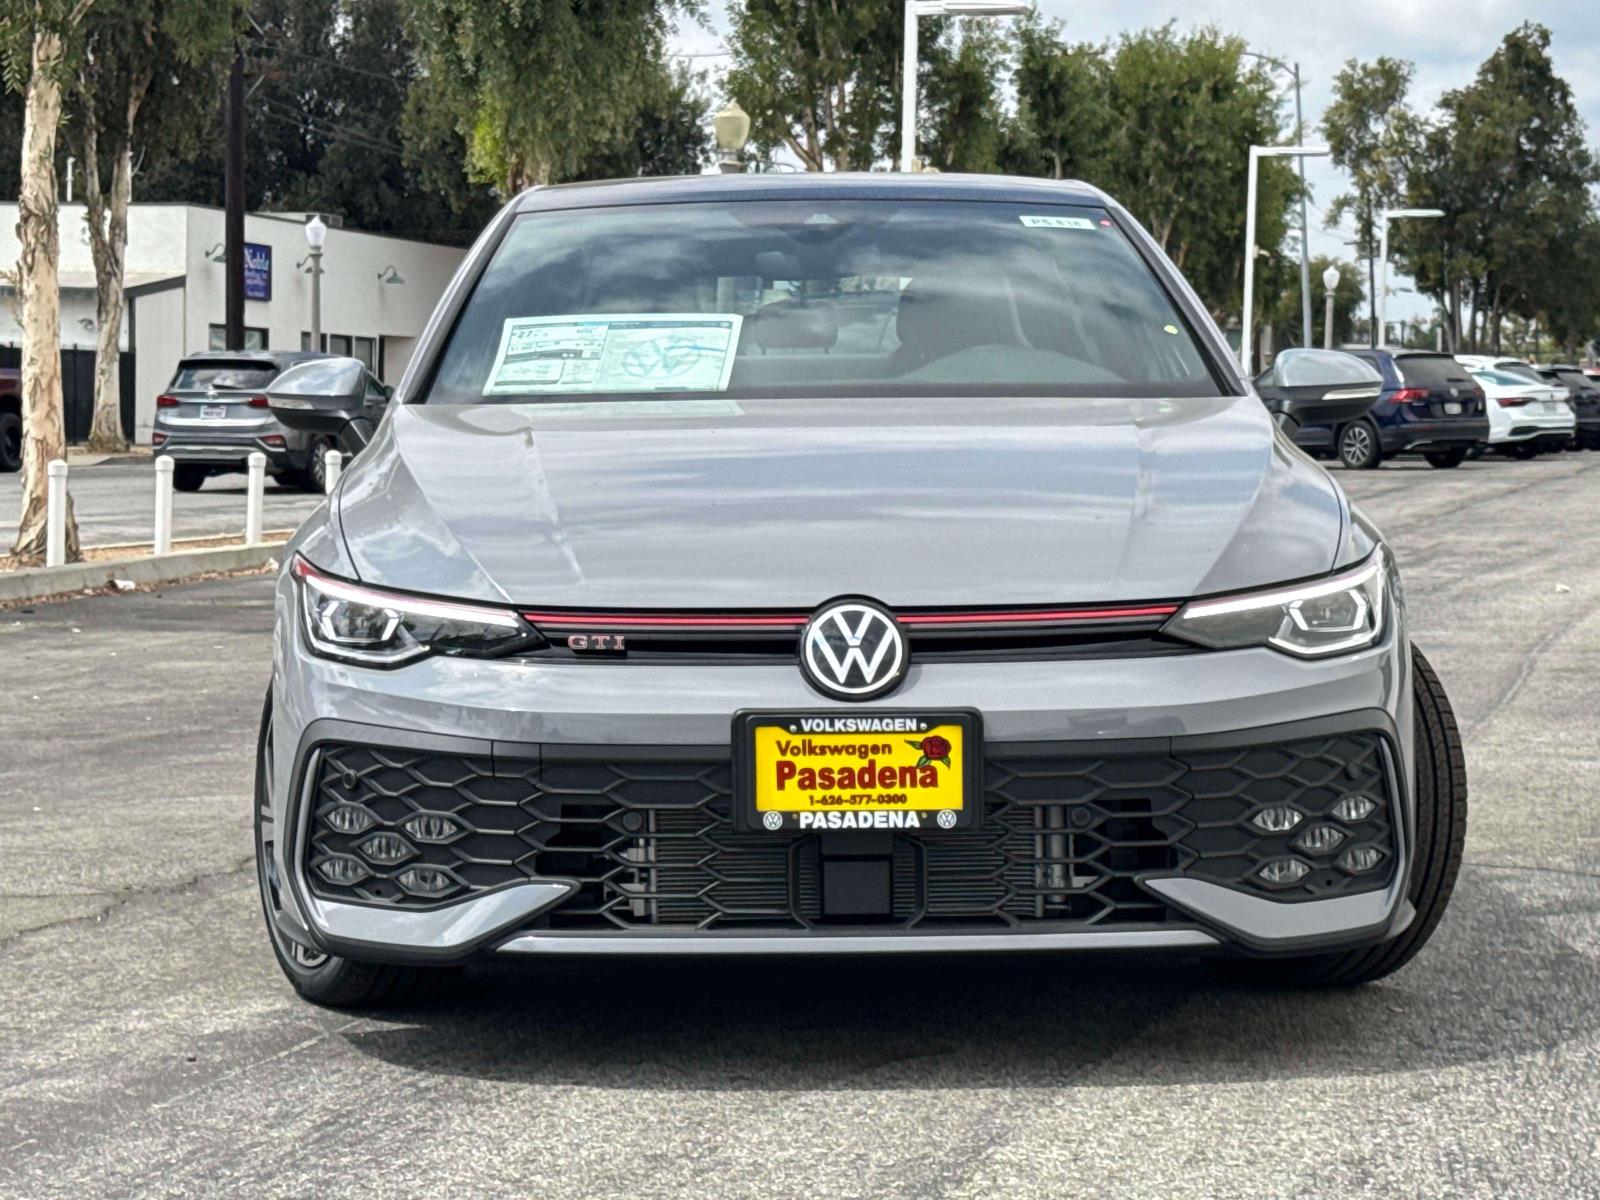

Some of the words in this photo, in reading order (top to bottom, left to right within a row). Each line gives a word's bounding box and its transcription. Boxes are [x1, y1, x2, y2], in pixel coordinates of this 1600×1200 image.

[567, 635, 625, 650] GTI
[800, 718, 917, 733] VOLKSWAGEN
[775, 739, 893, 759] Volkswagen
[775, 759, 939, 791] Pasadena
[808, 793, 908, 806] 1-626-577-0300
[799, 810, 921, 829] PASADENA
